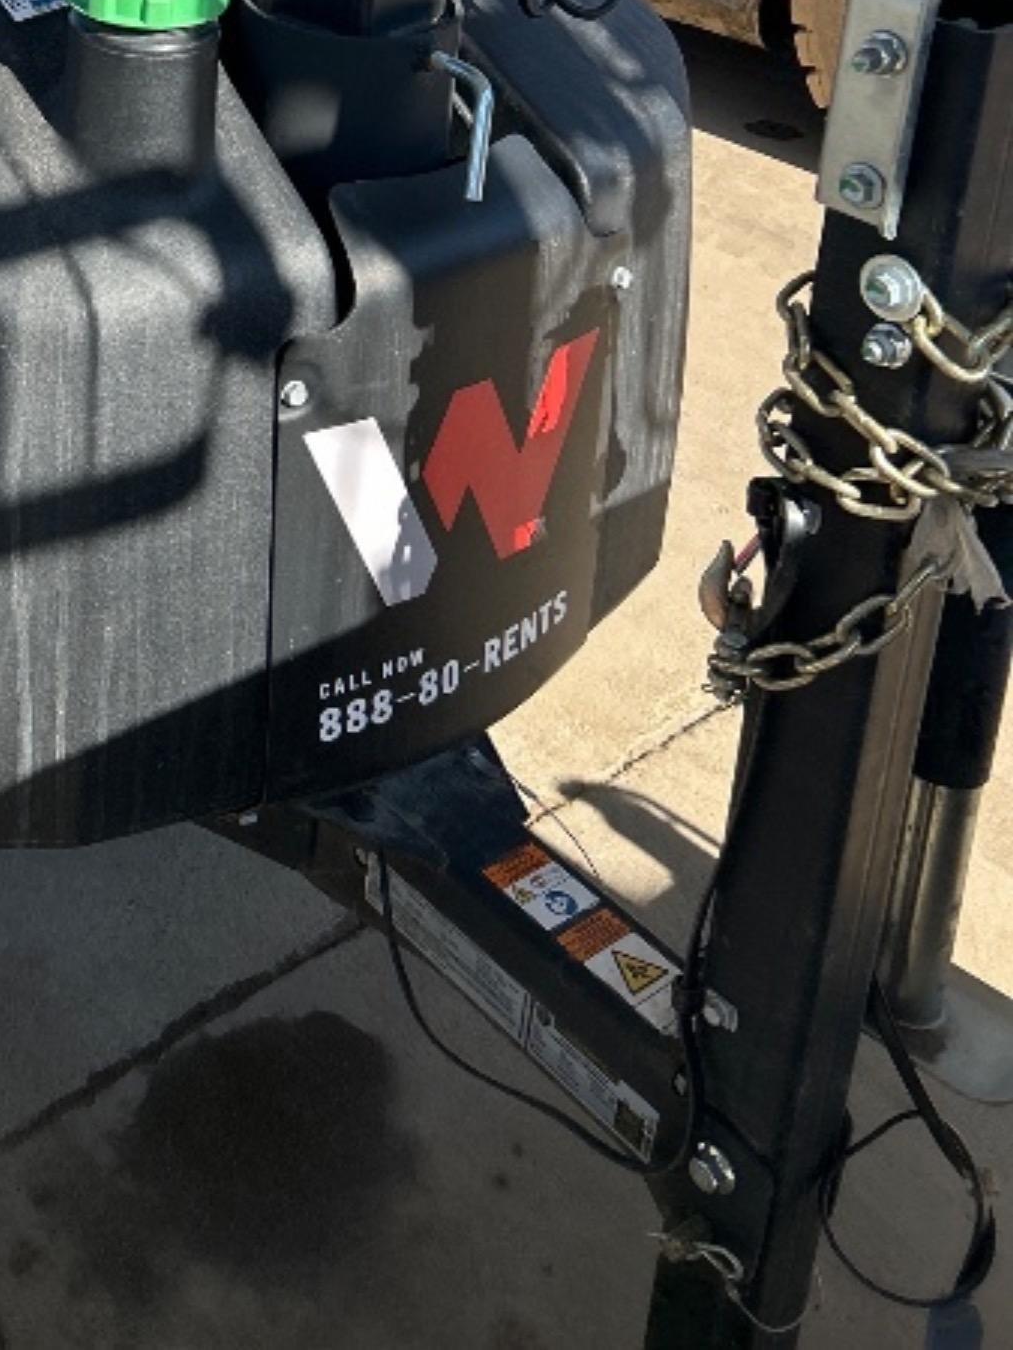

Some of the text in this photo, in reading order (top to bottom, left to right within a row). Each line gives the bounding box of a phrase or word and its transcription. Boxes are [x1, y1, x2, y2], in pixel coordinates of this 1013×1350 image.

[318, 590, 569, 744] 888-80-RENTS
[319, 648, 426, 700] CALL NOW
